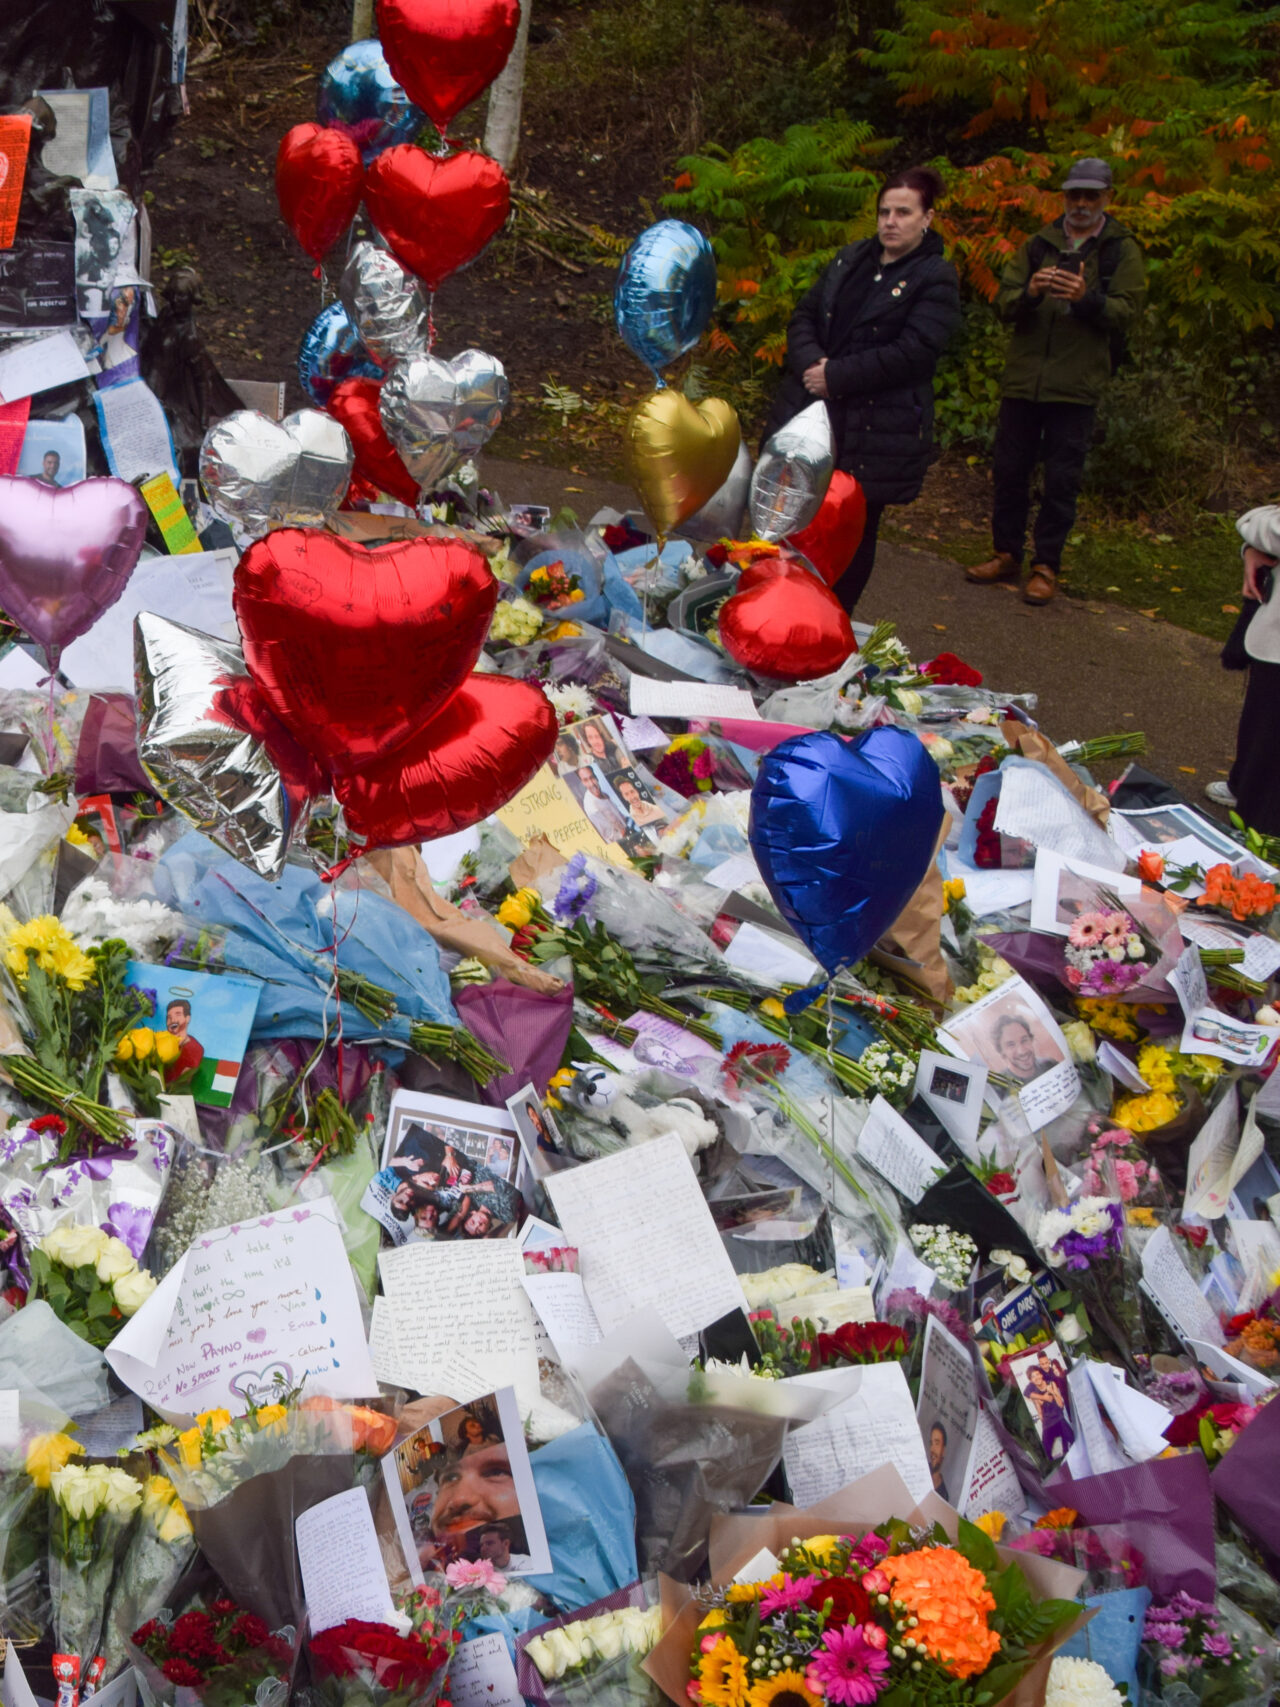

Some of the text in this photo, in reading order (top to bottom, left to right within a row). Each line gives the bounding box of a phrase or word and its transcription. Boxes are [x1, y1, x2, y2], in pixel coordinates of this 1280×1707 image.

[520, 783, 563, 816] STRONG
[553, 818, 591, 844] PERFECT
[246, 1240, 271, 1255] take
[281, 1233, 295, 1245] to
[193, 1263, 211, 1277] does
[220, 1278, 236, 1287] the
[243, 1269, 265, 1281] time
[1001, 1308, 1018, 1330] ONE
[200, 1341, 243, 1361] PAYNO
[191, 1366, 221, 1388] SPOONS
